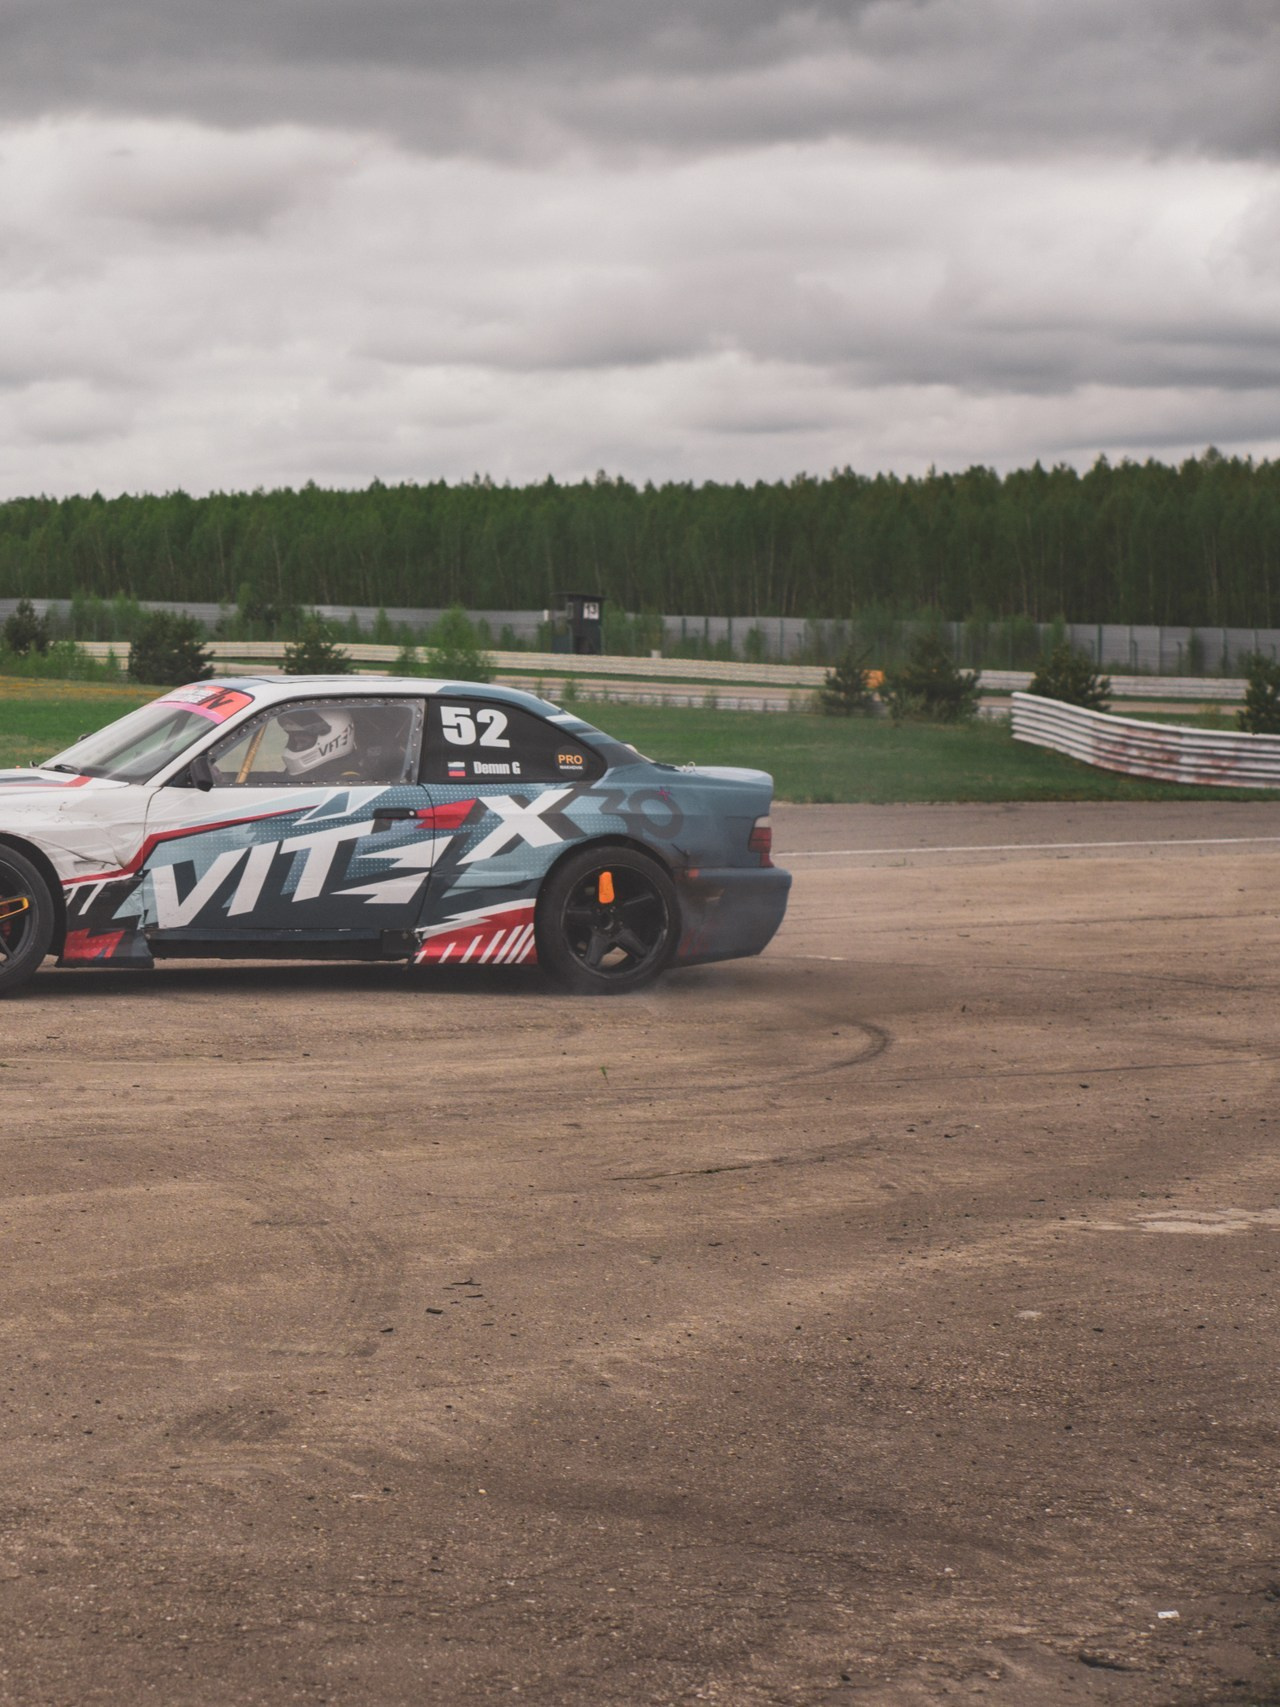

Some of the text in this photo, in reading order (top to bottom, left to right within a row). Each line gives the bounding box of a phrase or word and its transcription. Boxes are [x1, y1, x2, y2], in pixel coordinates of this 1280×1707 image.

[440, 706, 510, 748] 52
[558, 754, 583, 765] PRO
[511, 761, 521, 775] G
